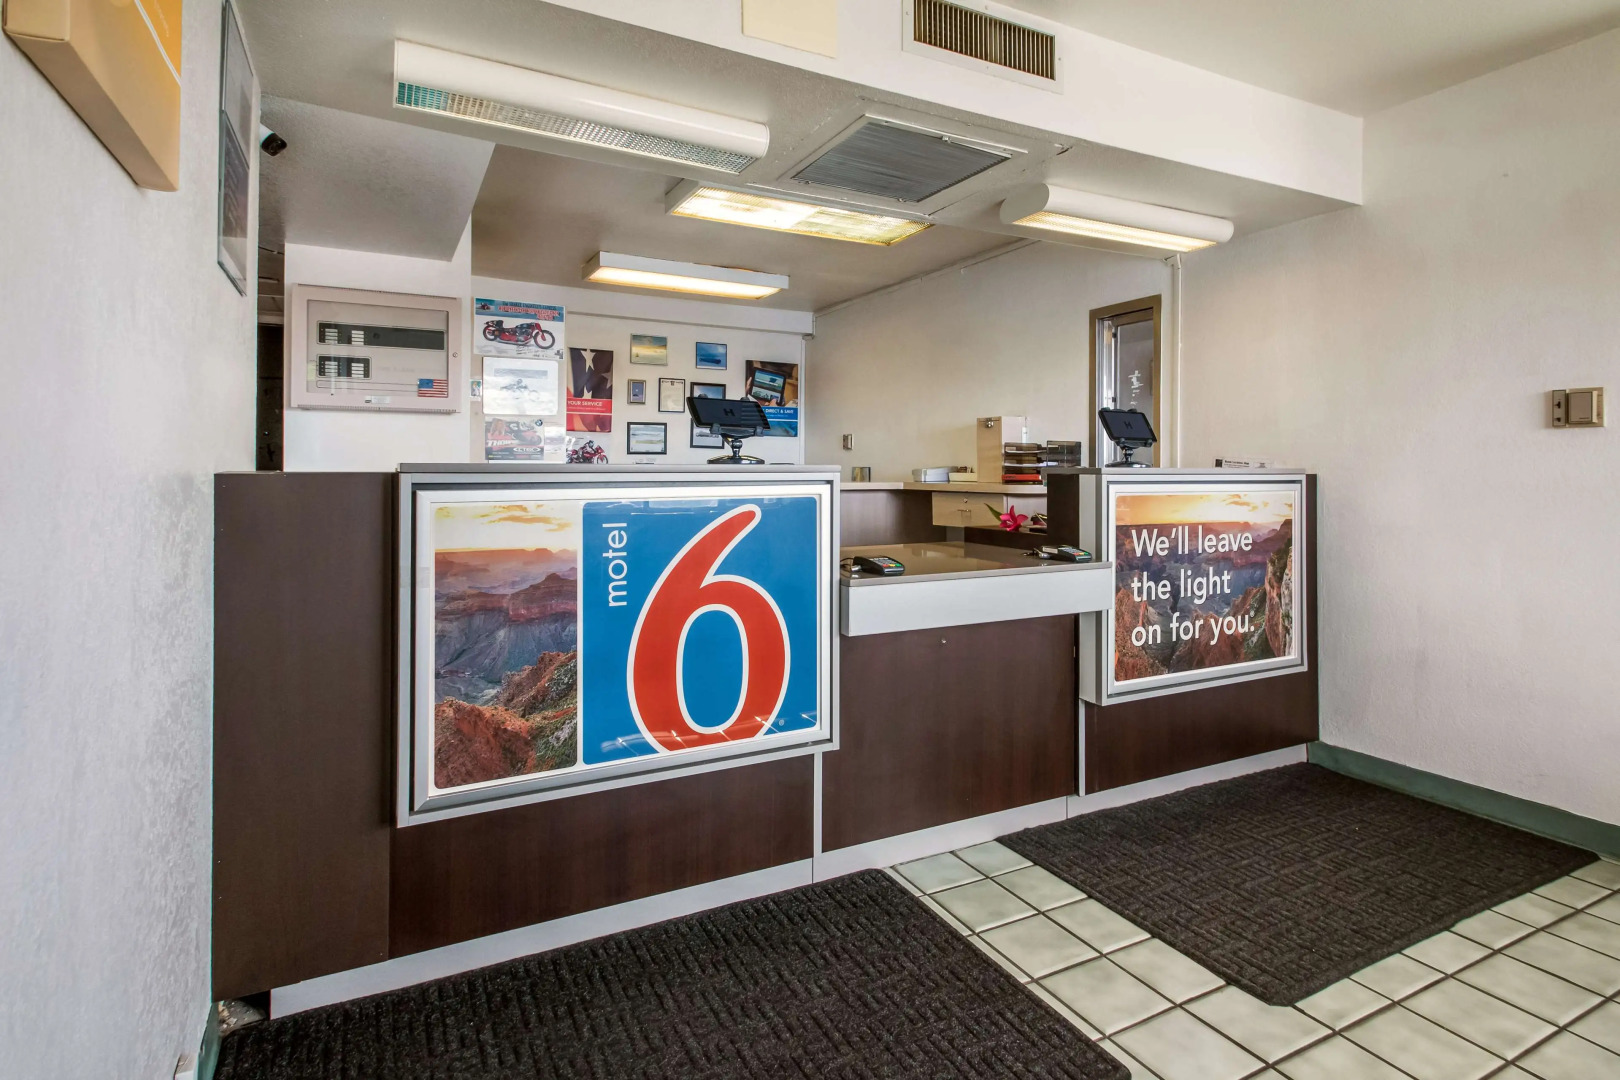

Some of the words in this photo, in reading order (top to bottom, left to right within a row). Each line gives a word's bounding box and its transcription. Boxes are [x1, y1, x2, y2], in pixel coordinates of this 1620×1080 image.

[1131, 525, 1189, 557] We'll
[1198, 525, 1253, 554] leave
[602, 522, 628, 607] motel
[1131, 571, 1171, 602] the
[1180, 566, 1231, 605] light
[626, 503, 792, 754] 6
[1131, 624, 1161, 647] on
[1170, 612, 1204, 642] for
